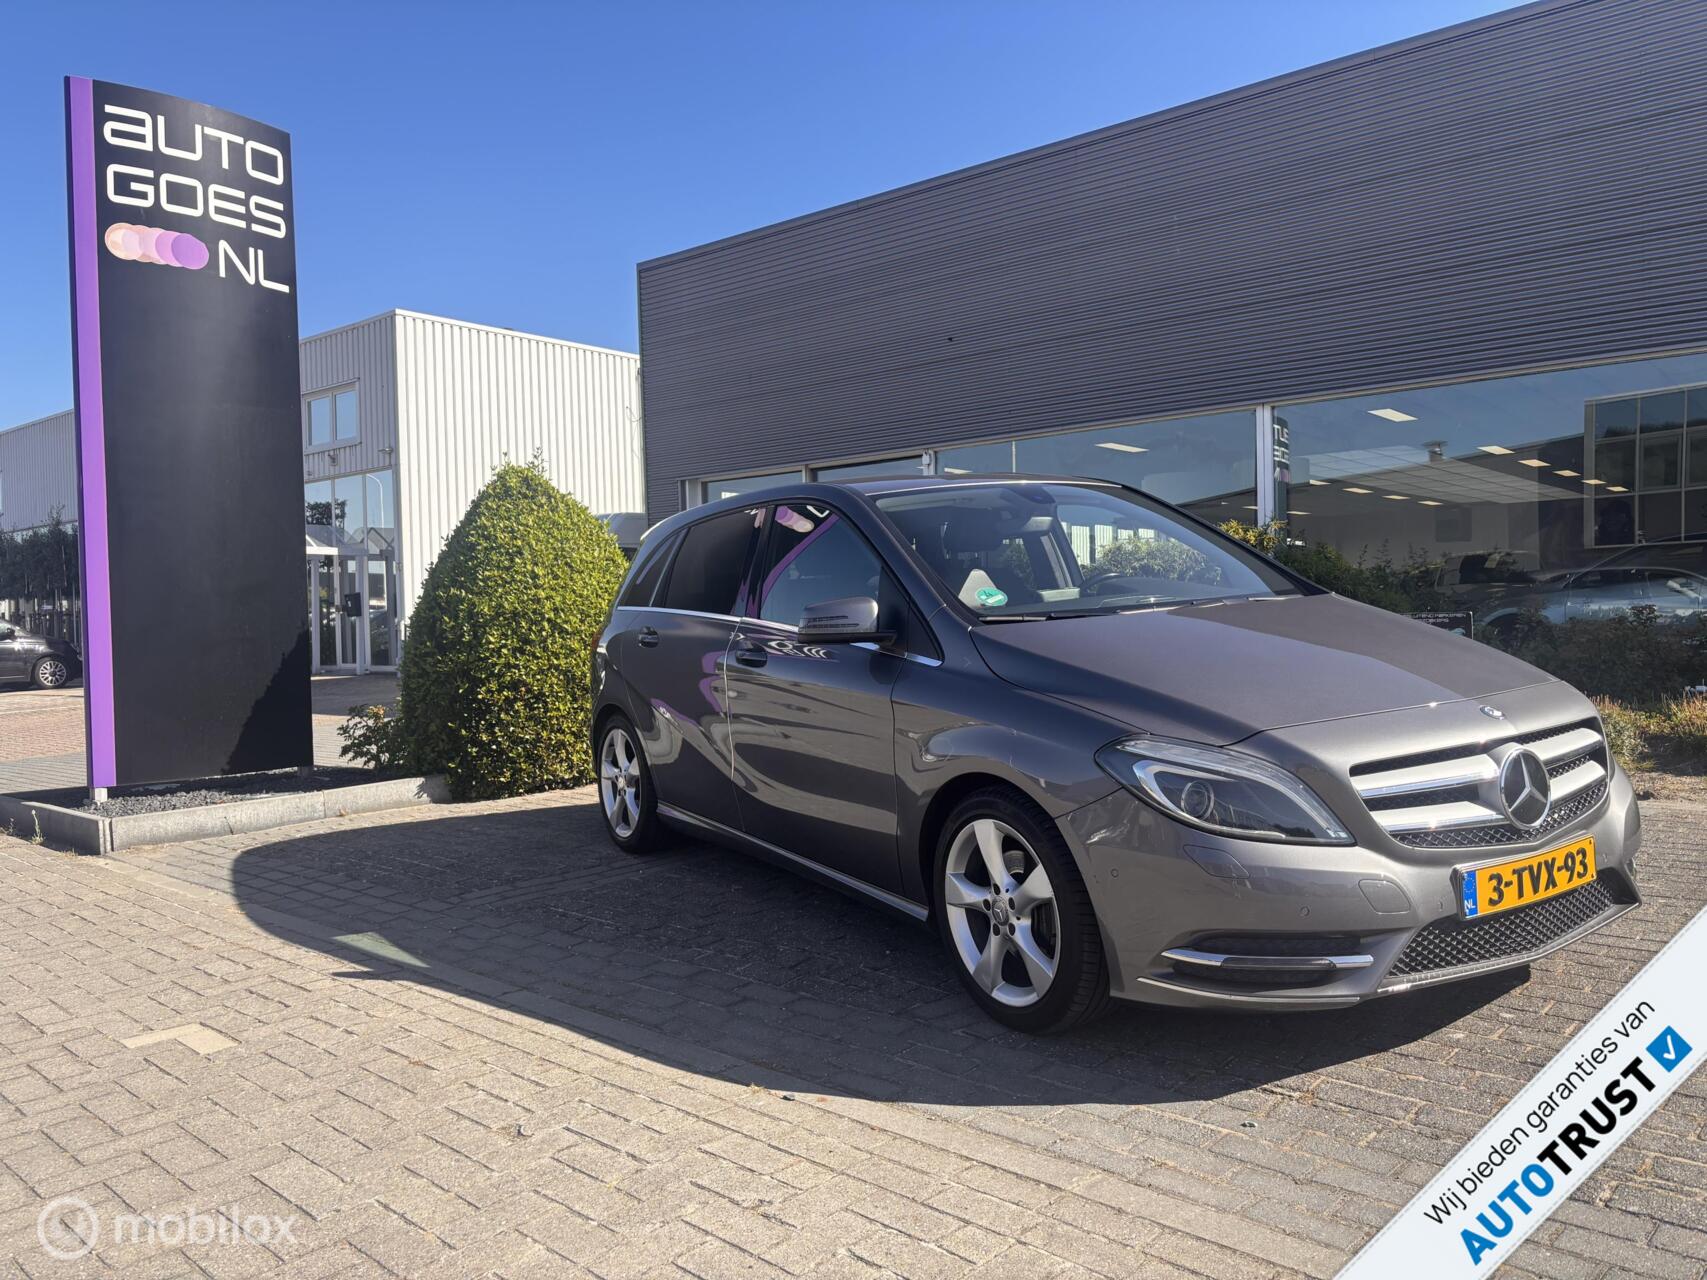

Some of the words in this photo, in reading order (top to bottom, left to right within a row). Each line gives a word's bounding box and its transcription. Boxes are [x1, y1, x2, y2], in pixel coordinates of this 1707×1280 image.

[106, 163, 286, 239] GOES
[218, 239, 290, 293] NL
[1464, 898, 1476, 911] NL
[1487, 847, 1588, 907] 3-TVX-93
